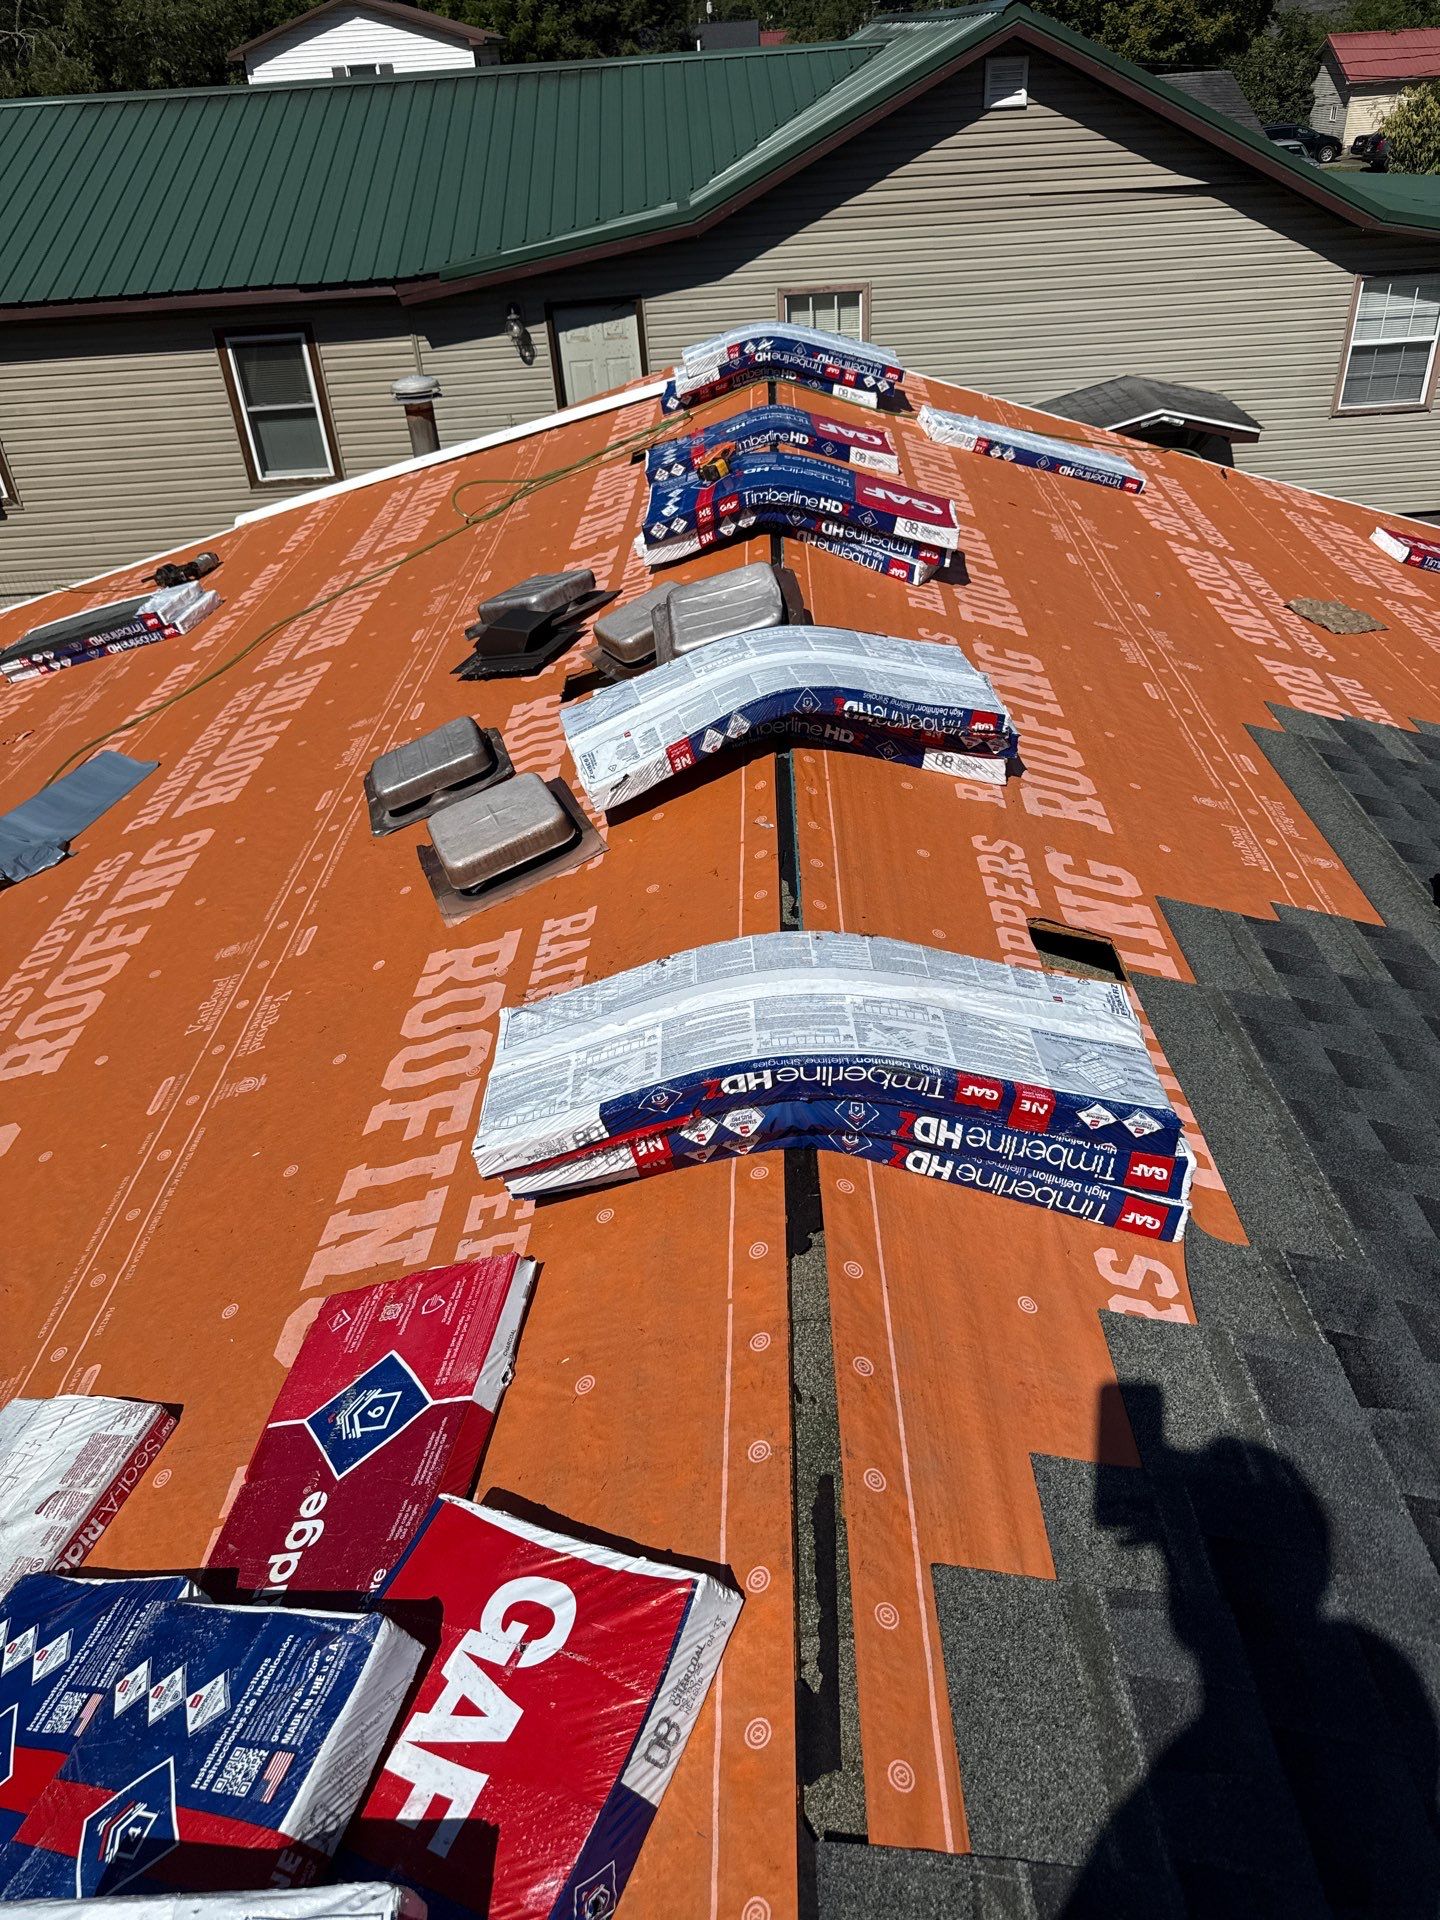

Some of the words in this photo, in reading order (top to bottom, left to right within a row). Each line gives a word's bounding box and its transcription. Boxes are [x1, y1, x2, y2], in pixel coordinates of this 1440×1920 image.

[771, 352, 823, 374] Timberline
[833, 356, 883, 378] Timberline
[737, 432, 790, 454] imberline
[818, 422, 882, 447] GAF
[901, 430, 977, 518] ROOFING
[1073, 467, 1122, 489] Timberline
[568, 461, 642, 552] ROOFING
[720, 500, 738, 514] GAF
[743, 490, 819, 514] Timberline
[819, 499, 851, 516] HDZ
[864, 484, 943, 516] GAF
[825, 537, 885, 573] Timberline
[844, 529, 914, 559] Timberline
[888, 567, 907, 580] GAF
[103, 621, 147, 641] Timberline
[121, 631, 163, 651] Timberline
[948, 706, 964, 718] High
[171, 661, 333, 818] ROOFING
[973, 638, 1115, 835] ROOFING
[122, 681, 263, 834] RAINSTOPPERS
[671, 753, 693, 769] NE
[0, 828, 217, 1082] ROOFING
[184, 975, 232, 1036] VanBoxel
[246, 990, 293, 1055] VanBoxel
[752, 1057, 801, 1070] Shingles
[919, 1066, 941, 1076] High
[703, 1065, 774, 1101] HDZ
[775, 1065, 946, 1099] Timberline
[961, 1086, 1000, 1101] GAF
[1018, 1099, 1049, 1115] NE
[897, 1110, 965, 1149] HDZ
[635, 1137, 665, 1158] NE
[888, 1143, 957, 1181] HDZ
[966, 1124, 1116, 1181] Timberline
[1128, 1163, 1169, 1180] GAF
[956, 1161, 1106, 1225] Timberline
[1084, 1184, 1112, 1201] High
[1121, 1210, 1162, 1231] GAF
[502, 1329, 517, 1357] CHARCOAL
[367, 1405, 385, 1419] 6
[260, 1489, 329, 1603] idge
[25, 1674, 67, 1732] Installation
[64, 1615, 106, 1674] instructions
[97, 1660, 117, 1688] MADE
[114, 1648, 125, 1659] IN
[121, 1629, 136, 1647] THE
[32, 1665, 80, 1733] Instrucciones
[79, 1649, 90, 1664] de
[151, 1674, 177, 1713] STAINGUARD
[157, 1693, 169, 1709] PLUS
[167, 1679, 178, 1693] PRO
[190, 1680, 220, 1726] WINDPROVEN
[191, 1726, 232, 1789] Installation
[227, 1657, 272, 1725] instructions
[199, 1716, 248, 1790] Instrucciones
[244, 1698, 257, 1715] de
[253, 1634, 295, 1697] instalación
[280, 1712, 304, 1745] MADE
[308, 1673, 325, 1697] THE
[384, 1575, 577, 1860] GAF
